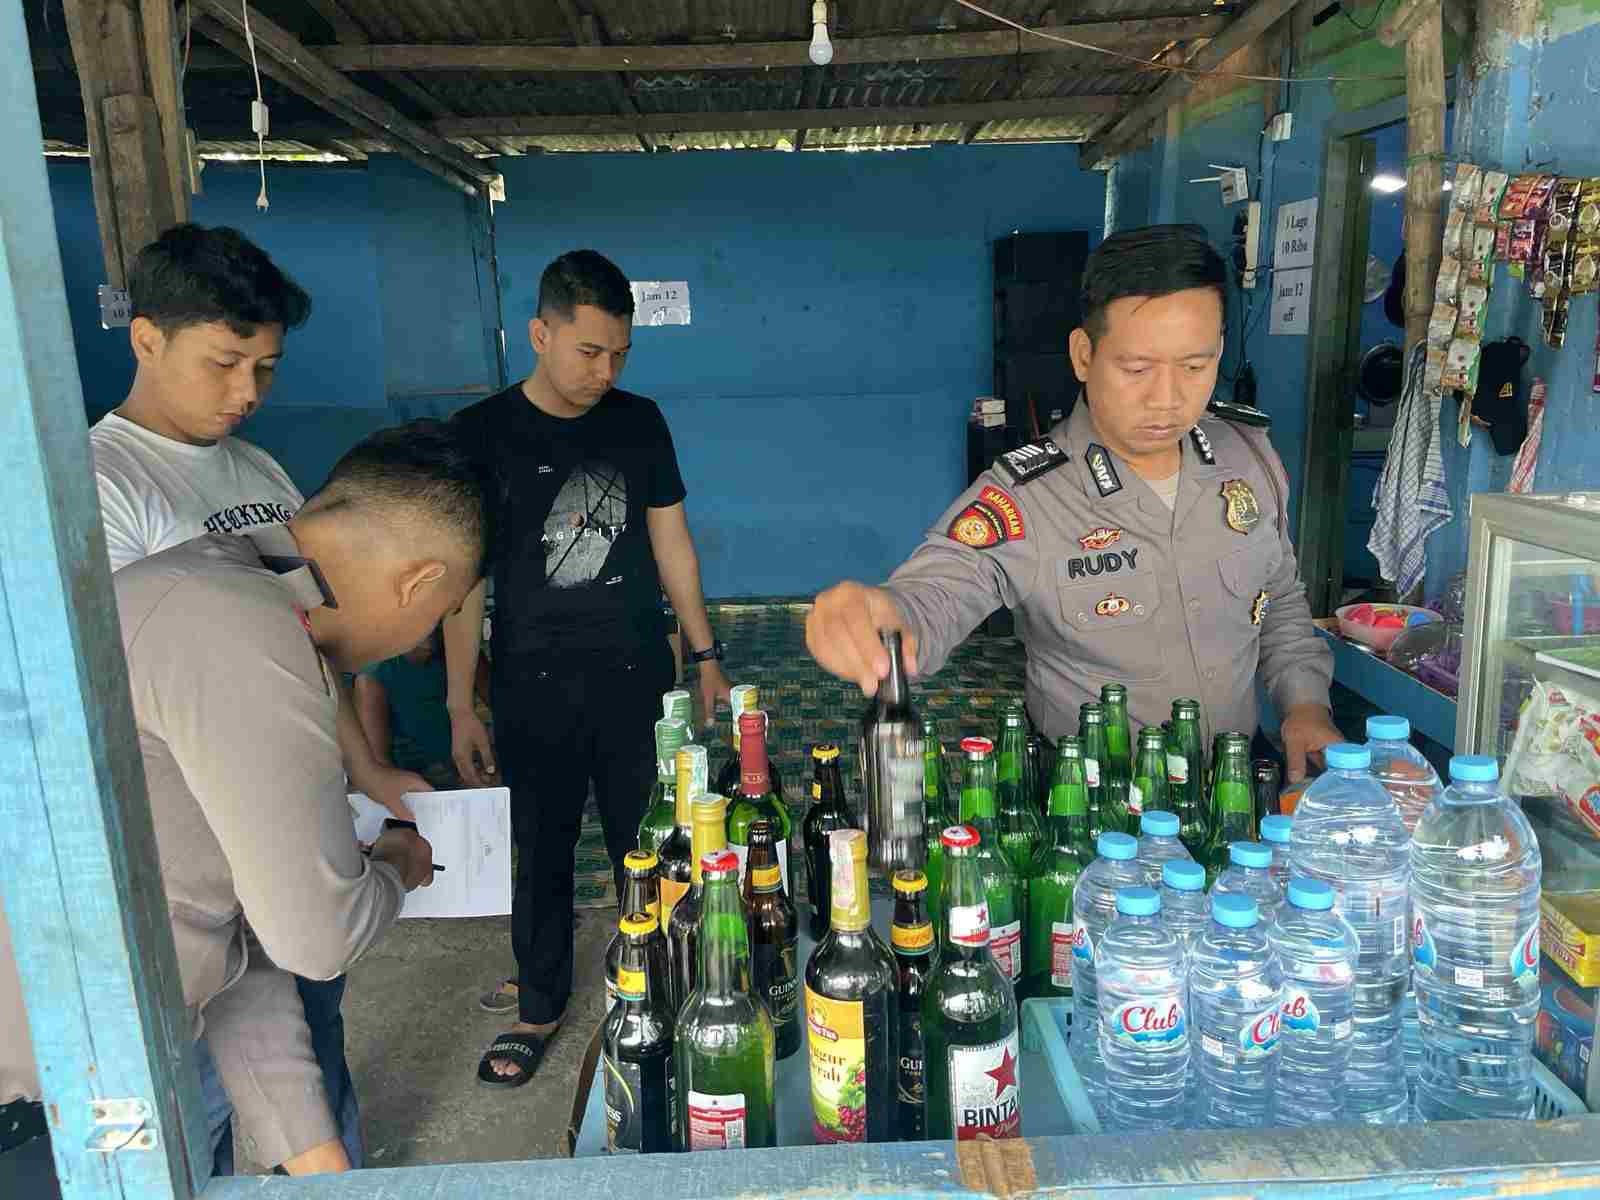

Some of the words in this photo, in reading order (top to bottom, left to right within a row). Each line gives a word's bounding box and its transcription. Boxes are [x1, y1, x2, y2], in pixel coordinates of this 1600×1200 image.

[665, 289, 680, 301] 12
[1295, 281, 1304, 297] 12
[1067, 548, 1138, 579] RUDY
[1122, 1003, 1178, 1033] Club
